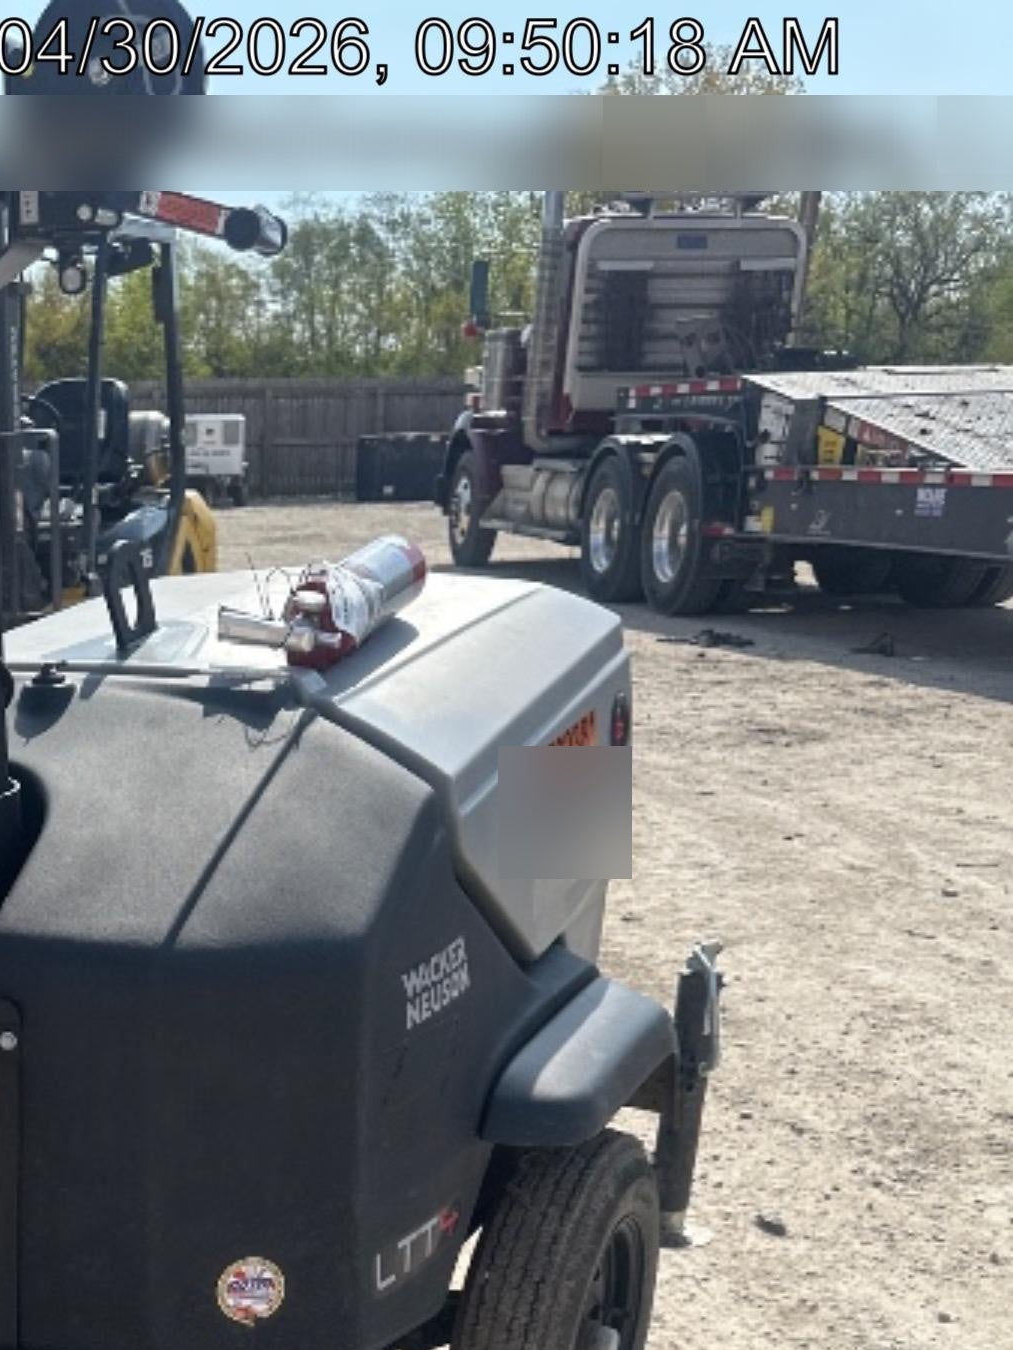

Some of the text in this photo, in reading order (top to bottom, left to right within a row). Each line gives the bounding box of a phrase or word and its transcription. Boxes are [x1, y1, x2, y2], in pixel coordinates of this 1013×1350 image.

[400, 936, 468, 998] WACKER
[406, 962, 470, 1030] NEUSON
[375, 1206, 460, 1291] LTT4
